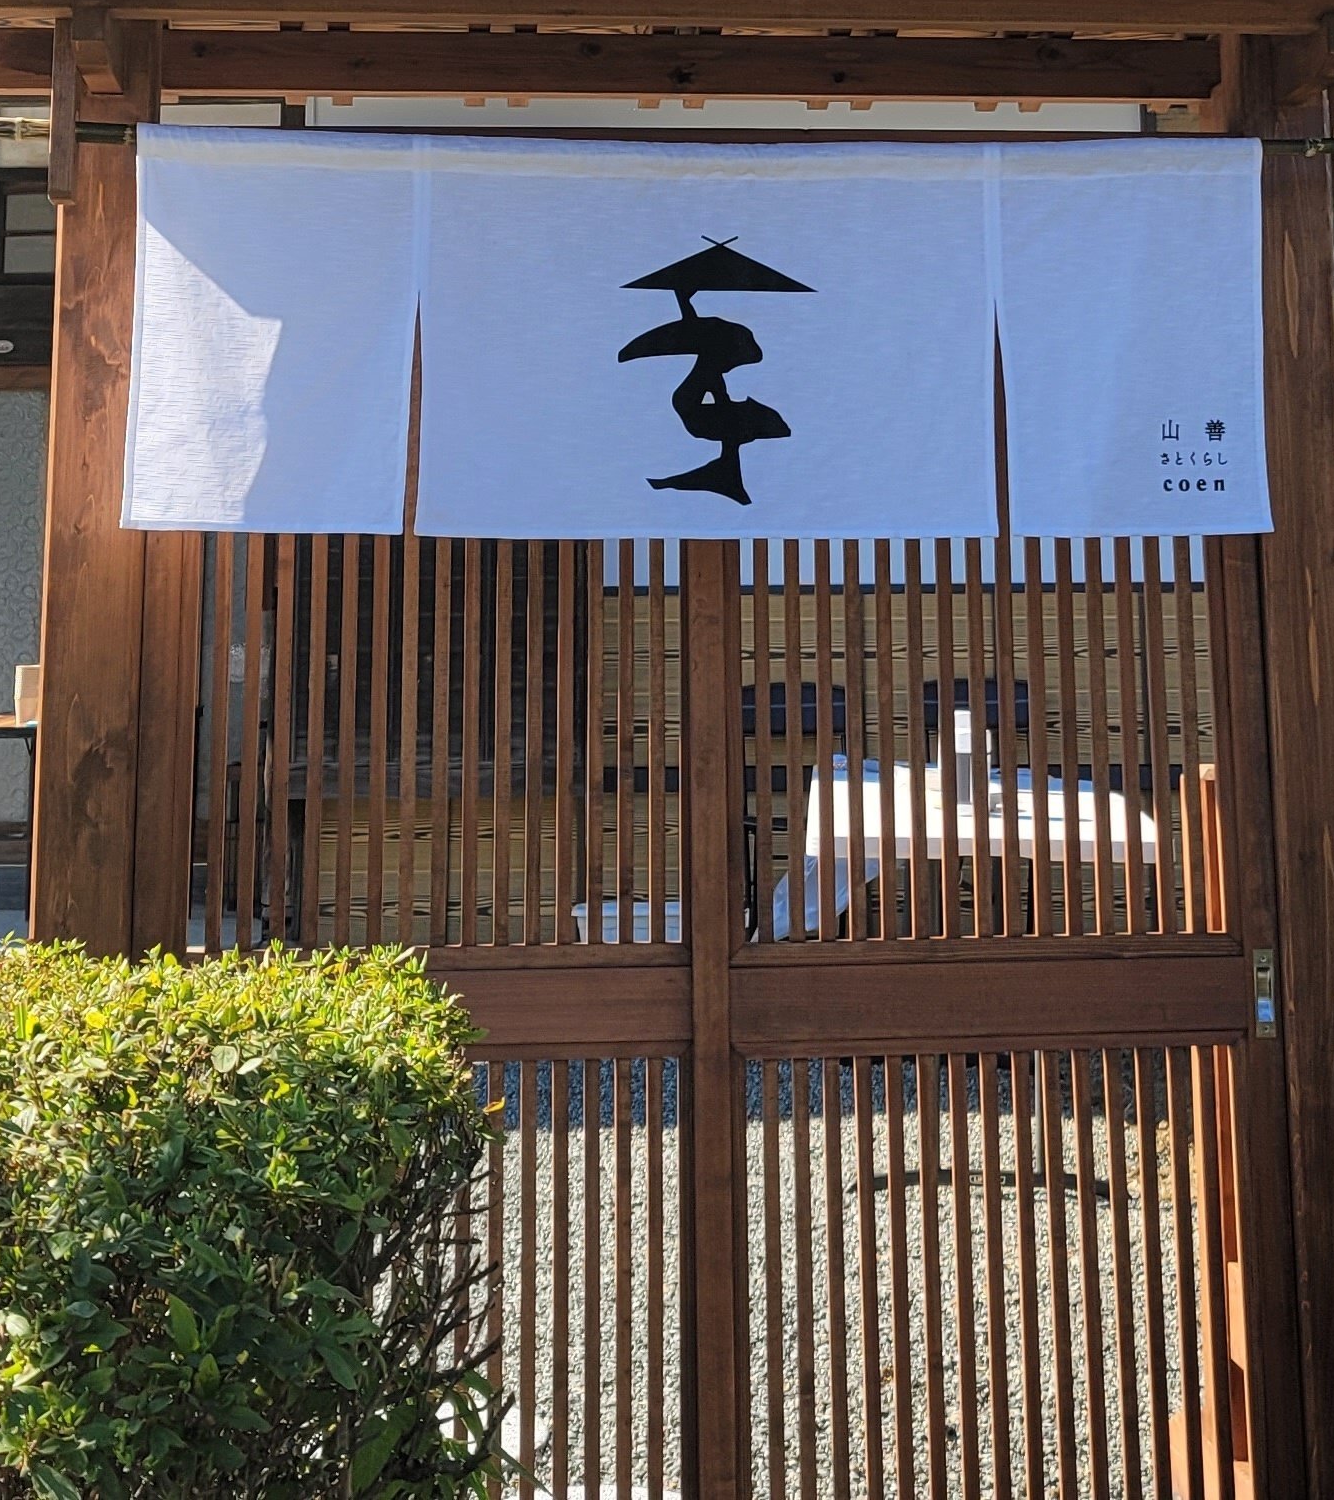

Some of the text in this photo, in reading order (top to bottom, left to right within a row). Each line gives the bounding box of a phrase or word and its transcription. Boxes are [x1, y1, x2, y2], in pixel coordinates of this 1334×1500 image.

[1162, 419, 1226, 441] 山善
[1160, 452, 1228, 467] さとくらし
[1163, 478, 1225, 491] coen
